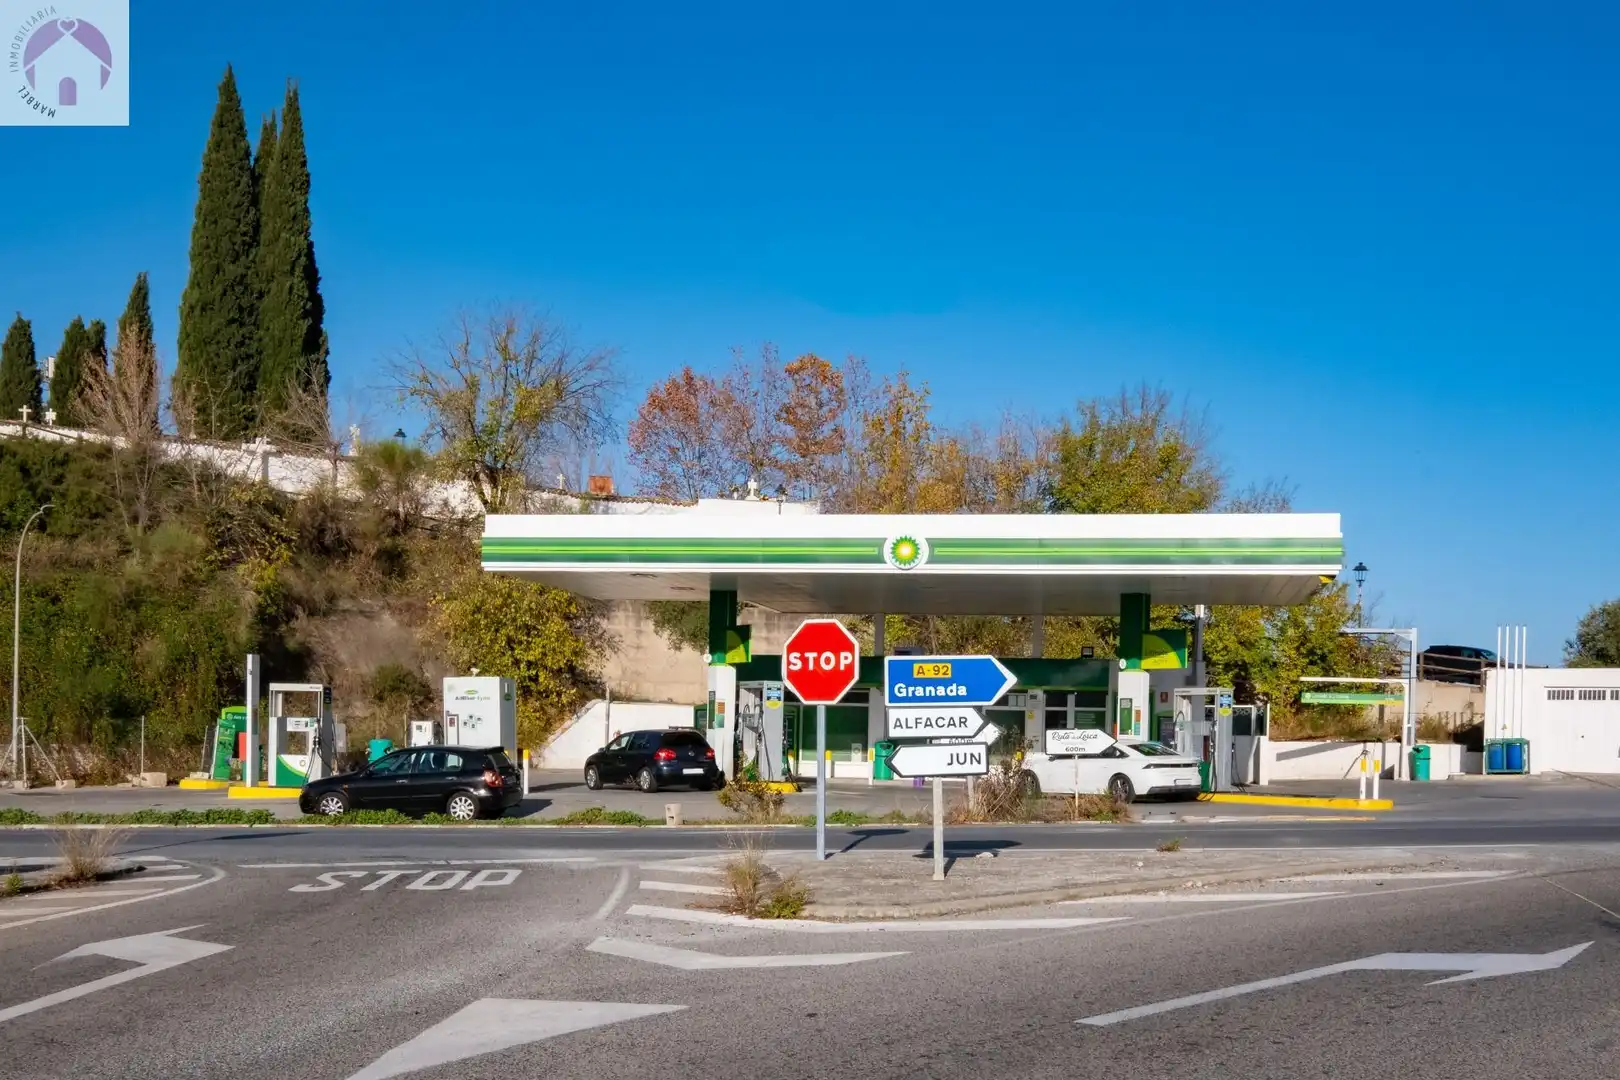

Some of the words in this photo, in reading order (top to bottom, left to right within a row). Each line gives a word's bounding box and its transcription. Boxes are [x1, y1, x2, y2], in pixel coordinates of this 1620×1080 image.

[788, 651, 853, 671] STOP
[916, 664, 950, 676] A-92
[894, 683, 968, 697] Granada
[893, 716, 968, 730] ALFACAR
[947, 752, 982, 766] JUN
[288, 869, 523, 892] STOP
